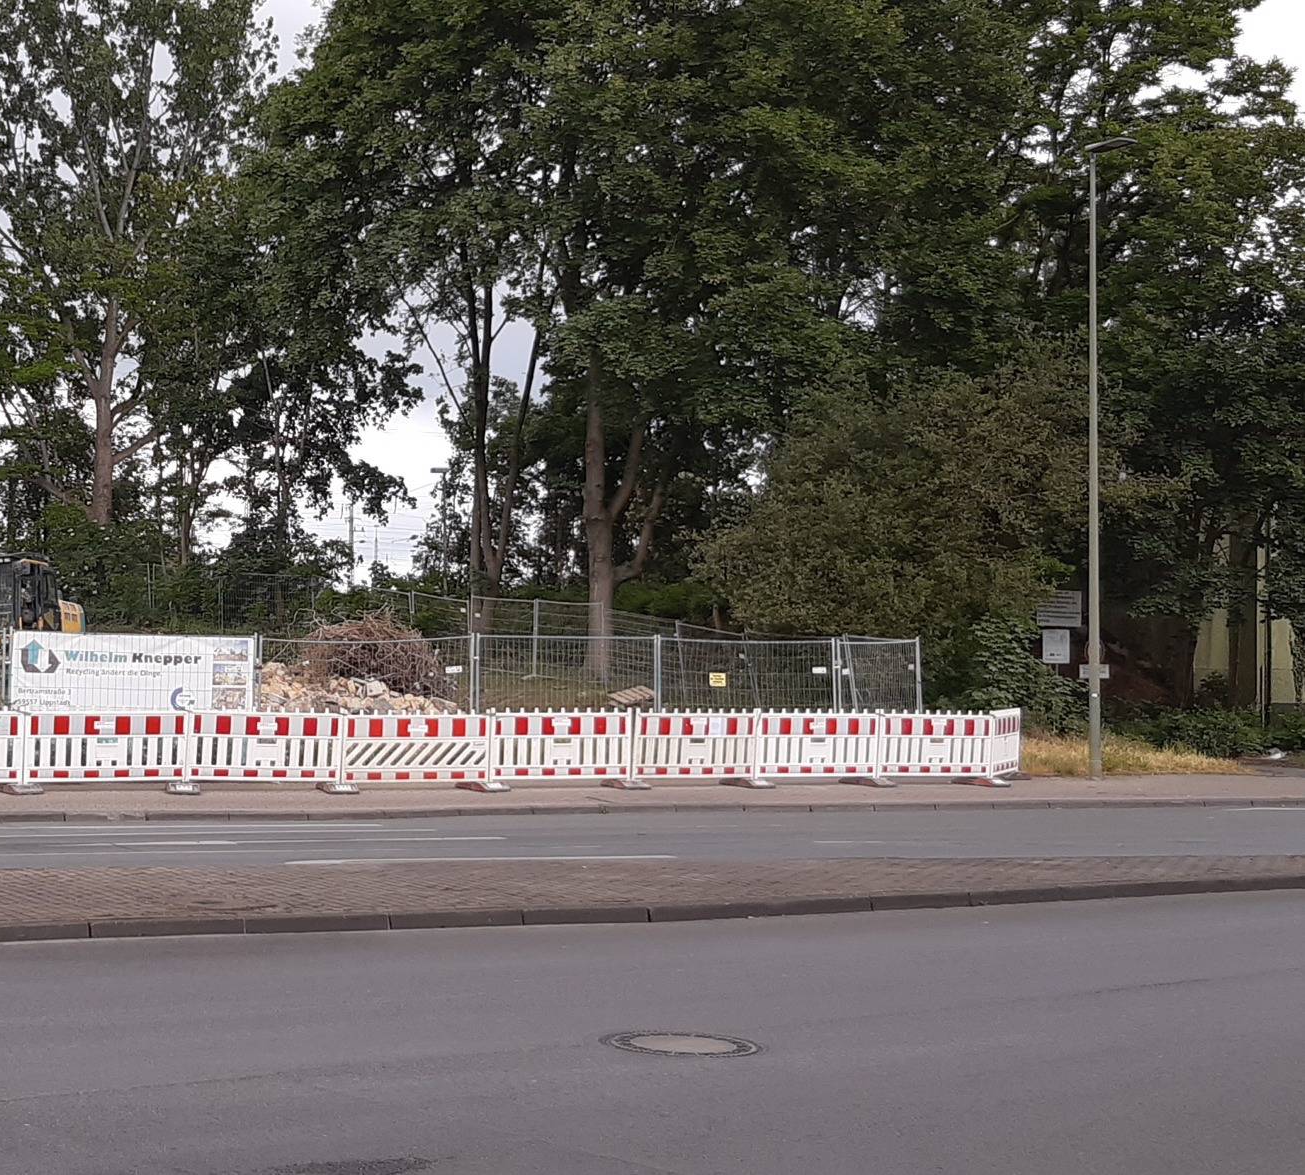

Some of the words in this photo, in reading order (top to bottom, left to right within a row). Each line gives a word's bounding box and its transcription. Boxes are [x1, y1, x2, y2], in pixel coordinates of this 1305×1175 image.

[64, 650, 128, 663] Wilhelm
[131, 652, 202, 666] Knepper
[66, 668, 100, 676] Recycling
[39, 699, 71, 708] Lippstadt
